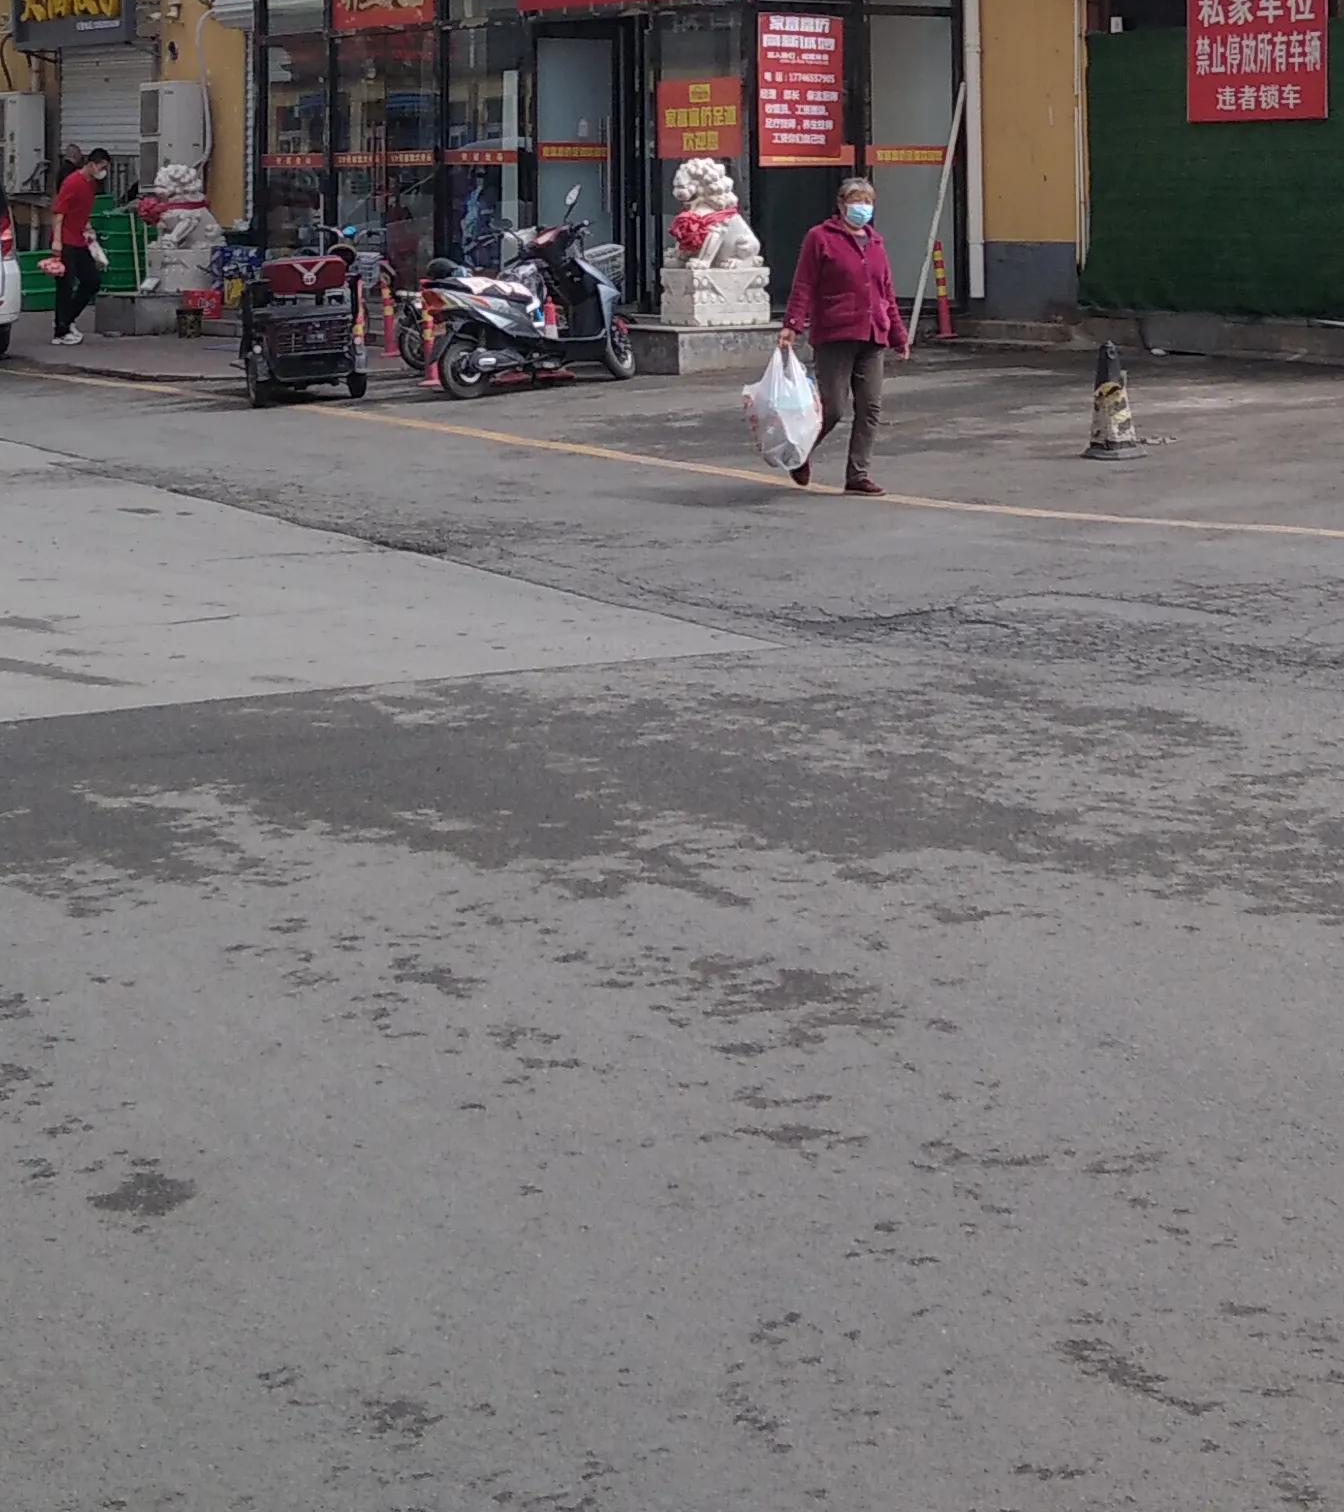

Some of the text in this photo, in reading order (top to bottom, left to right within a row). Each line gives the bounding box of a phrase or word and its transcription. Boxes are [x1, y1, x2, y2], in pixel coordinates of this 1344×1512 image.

[1195, 30, 1321, 76] 禁止停放所有车辆
[1215, 84, 1302, 112] 违者锁车
